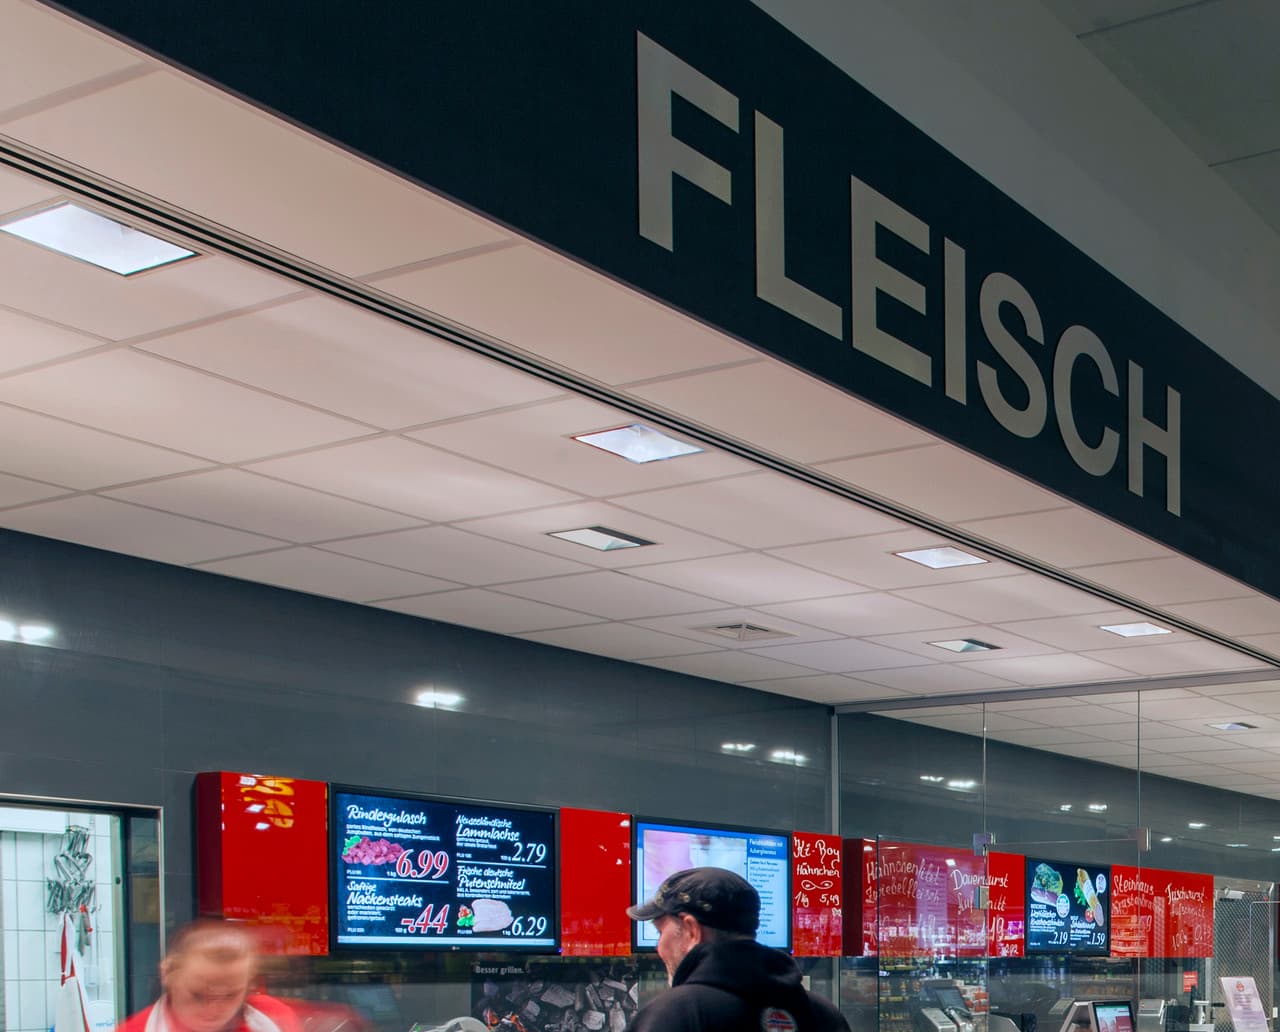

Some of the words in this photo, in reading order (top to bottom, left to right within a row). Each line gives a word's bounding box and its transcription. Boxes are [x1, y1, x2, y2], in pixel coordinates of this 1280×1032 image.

[637, 30, 1181, 517] FLEISCH
[347, 804, 427, 828] Rindergulasch
[511, 842, 547, 863] 2.79
[396, 849, 450, 879] 6.99
[483, 868, 515, 878] deutsche
[796, 861, 841, 878] Hähnchen
[347, 880, 377, 895] Saftige
[457, 875, 526, 890] Putenschnitzel
[951, 869, 1009, 891] Dauerwurst
[346, 891, 424, 908] Nackensteaks
[511, 916, 548, 937] 6.29
[475, 965, 499, 974] Besser
